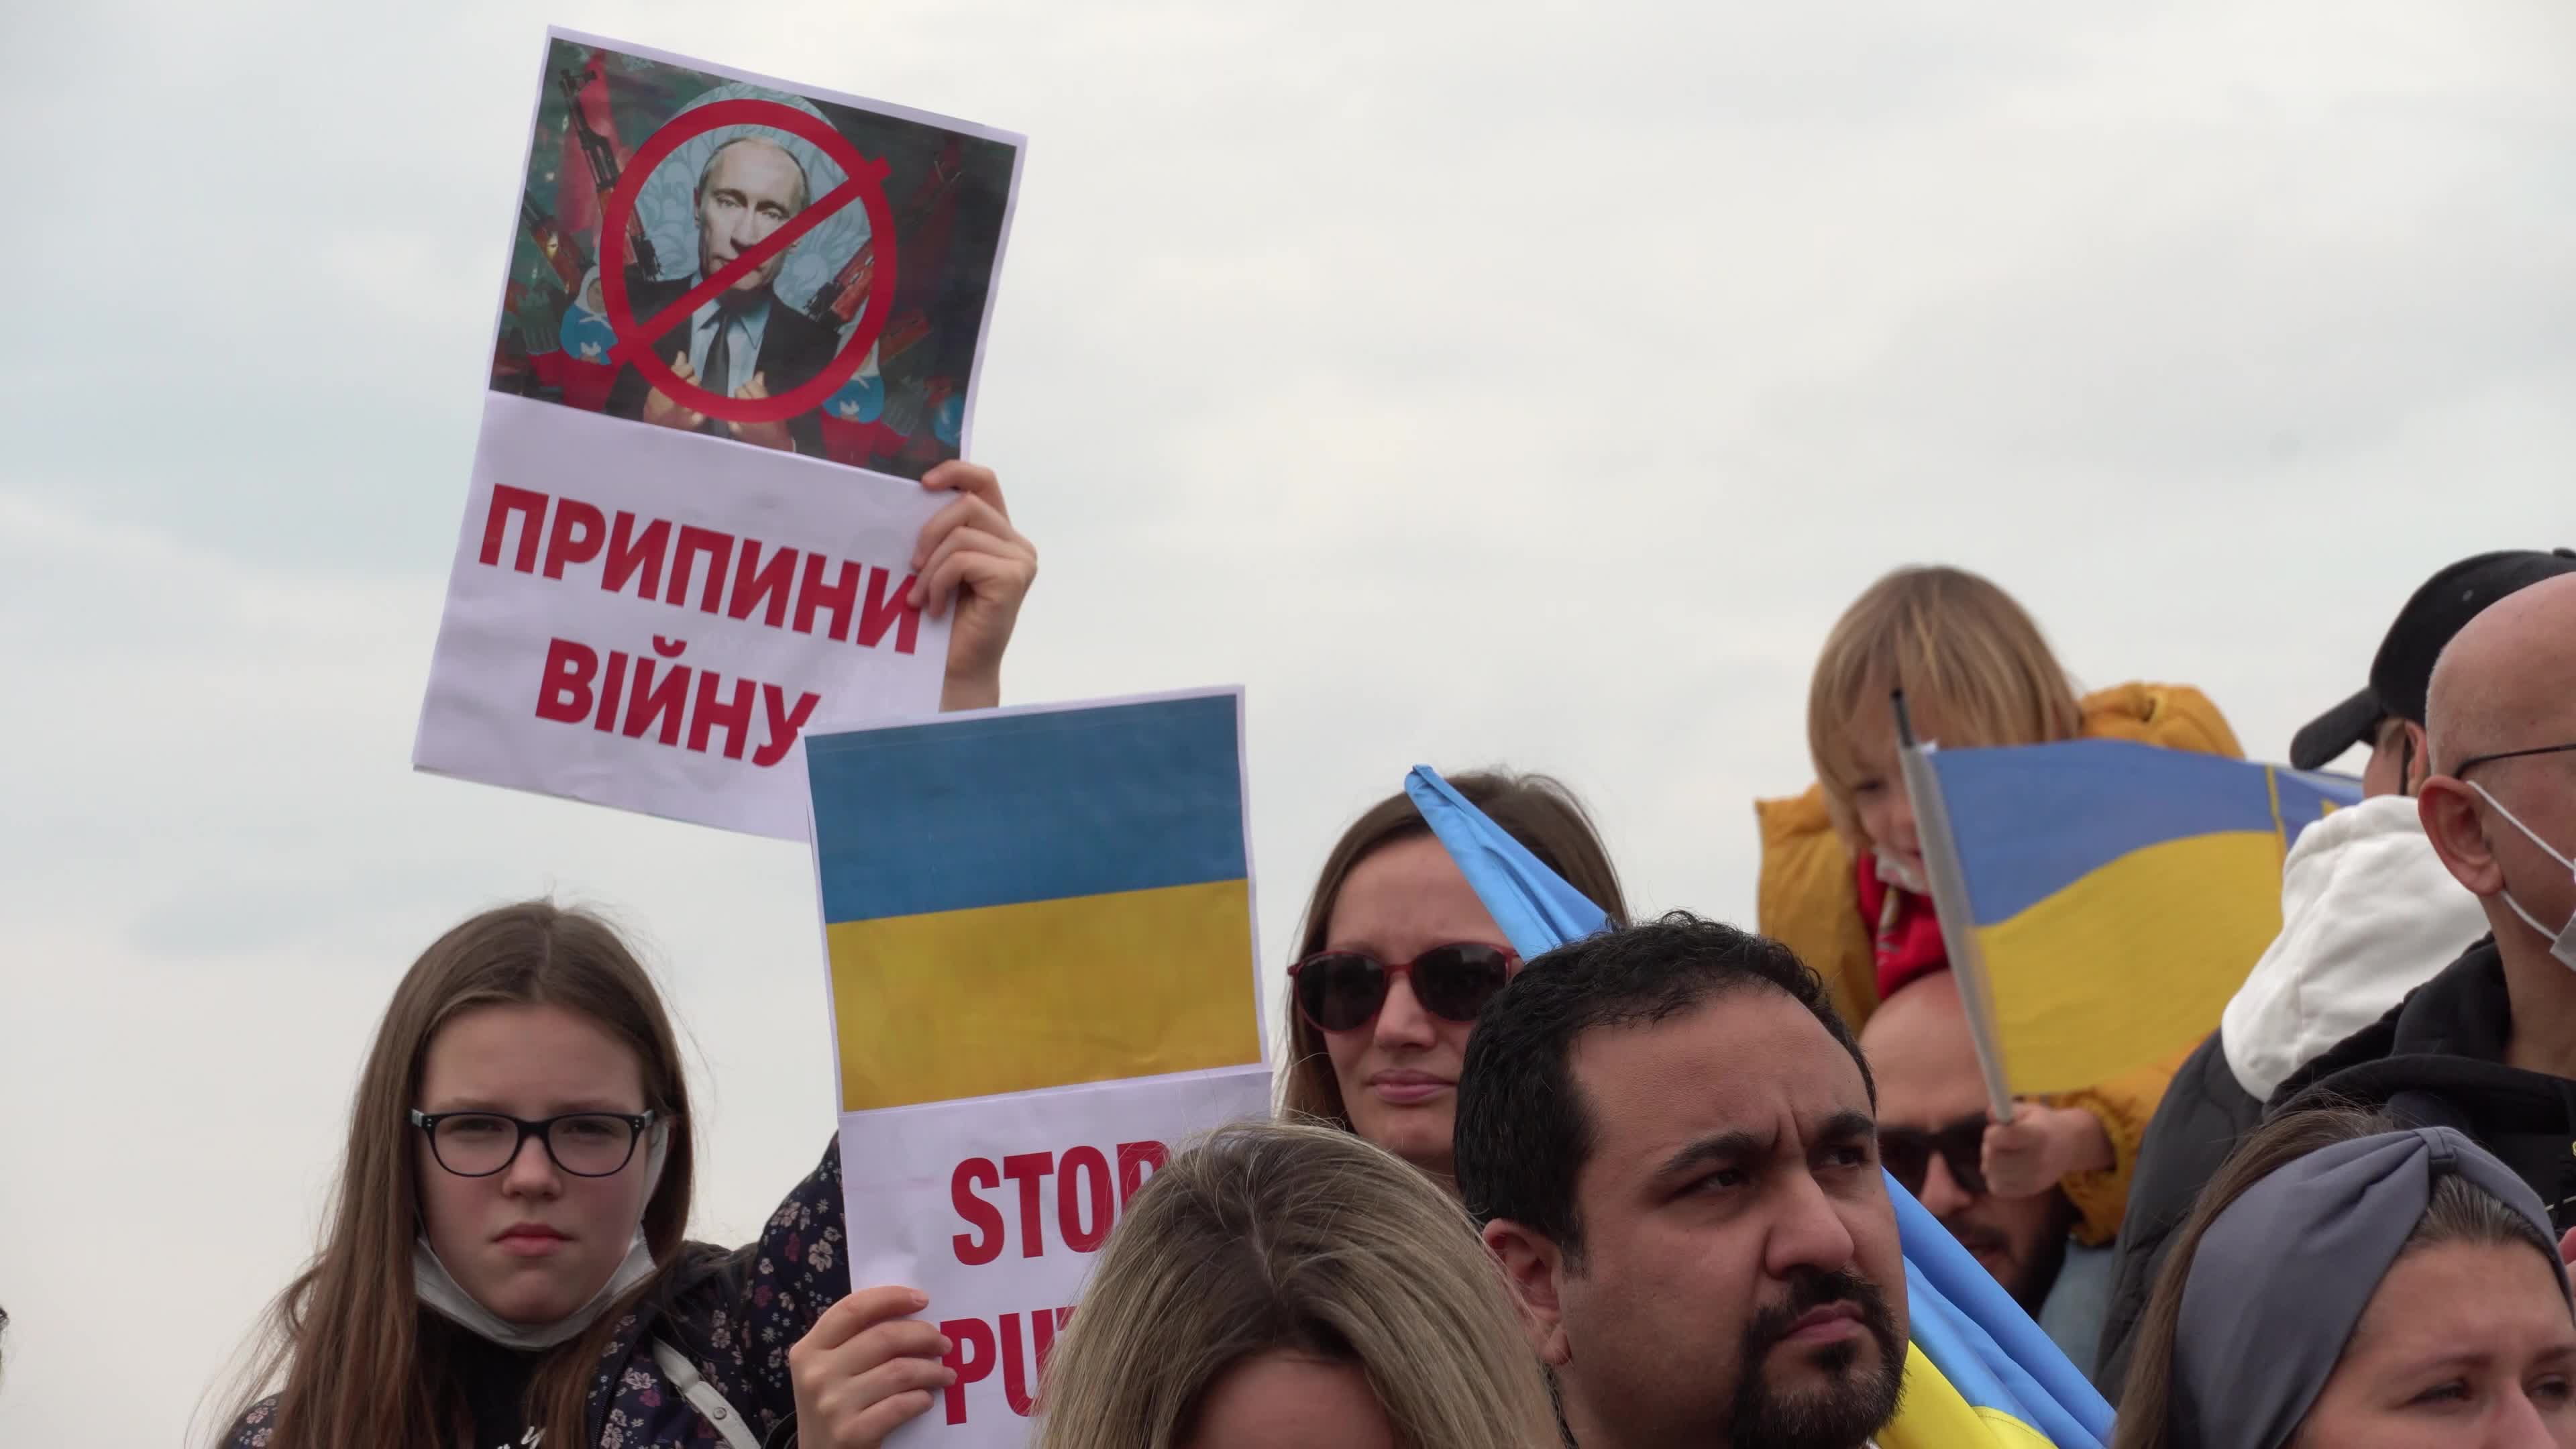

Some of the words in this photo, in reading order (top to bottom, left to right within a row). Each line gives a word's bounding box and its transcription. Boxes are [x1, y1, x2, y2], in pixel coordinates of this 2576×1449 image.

[479, 482, 922, 655] ПРИПИНИ
[535, 635, 821, 767] ВІЙНУ
[940, 1306, 1077, 1425] PU
